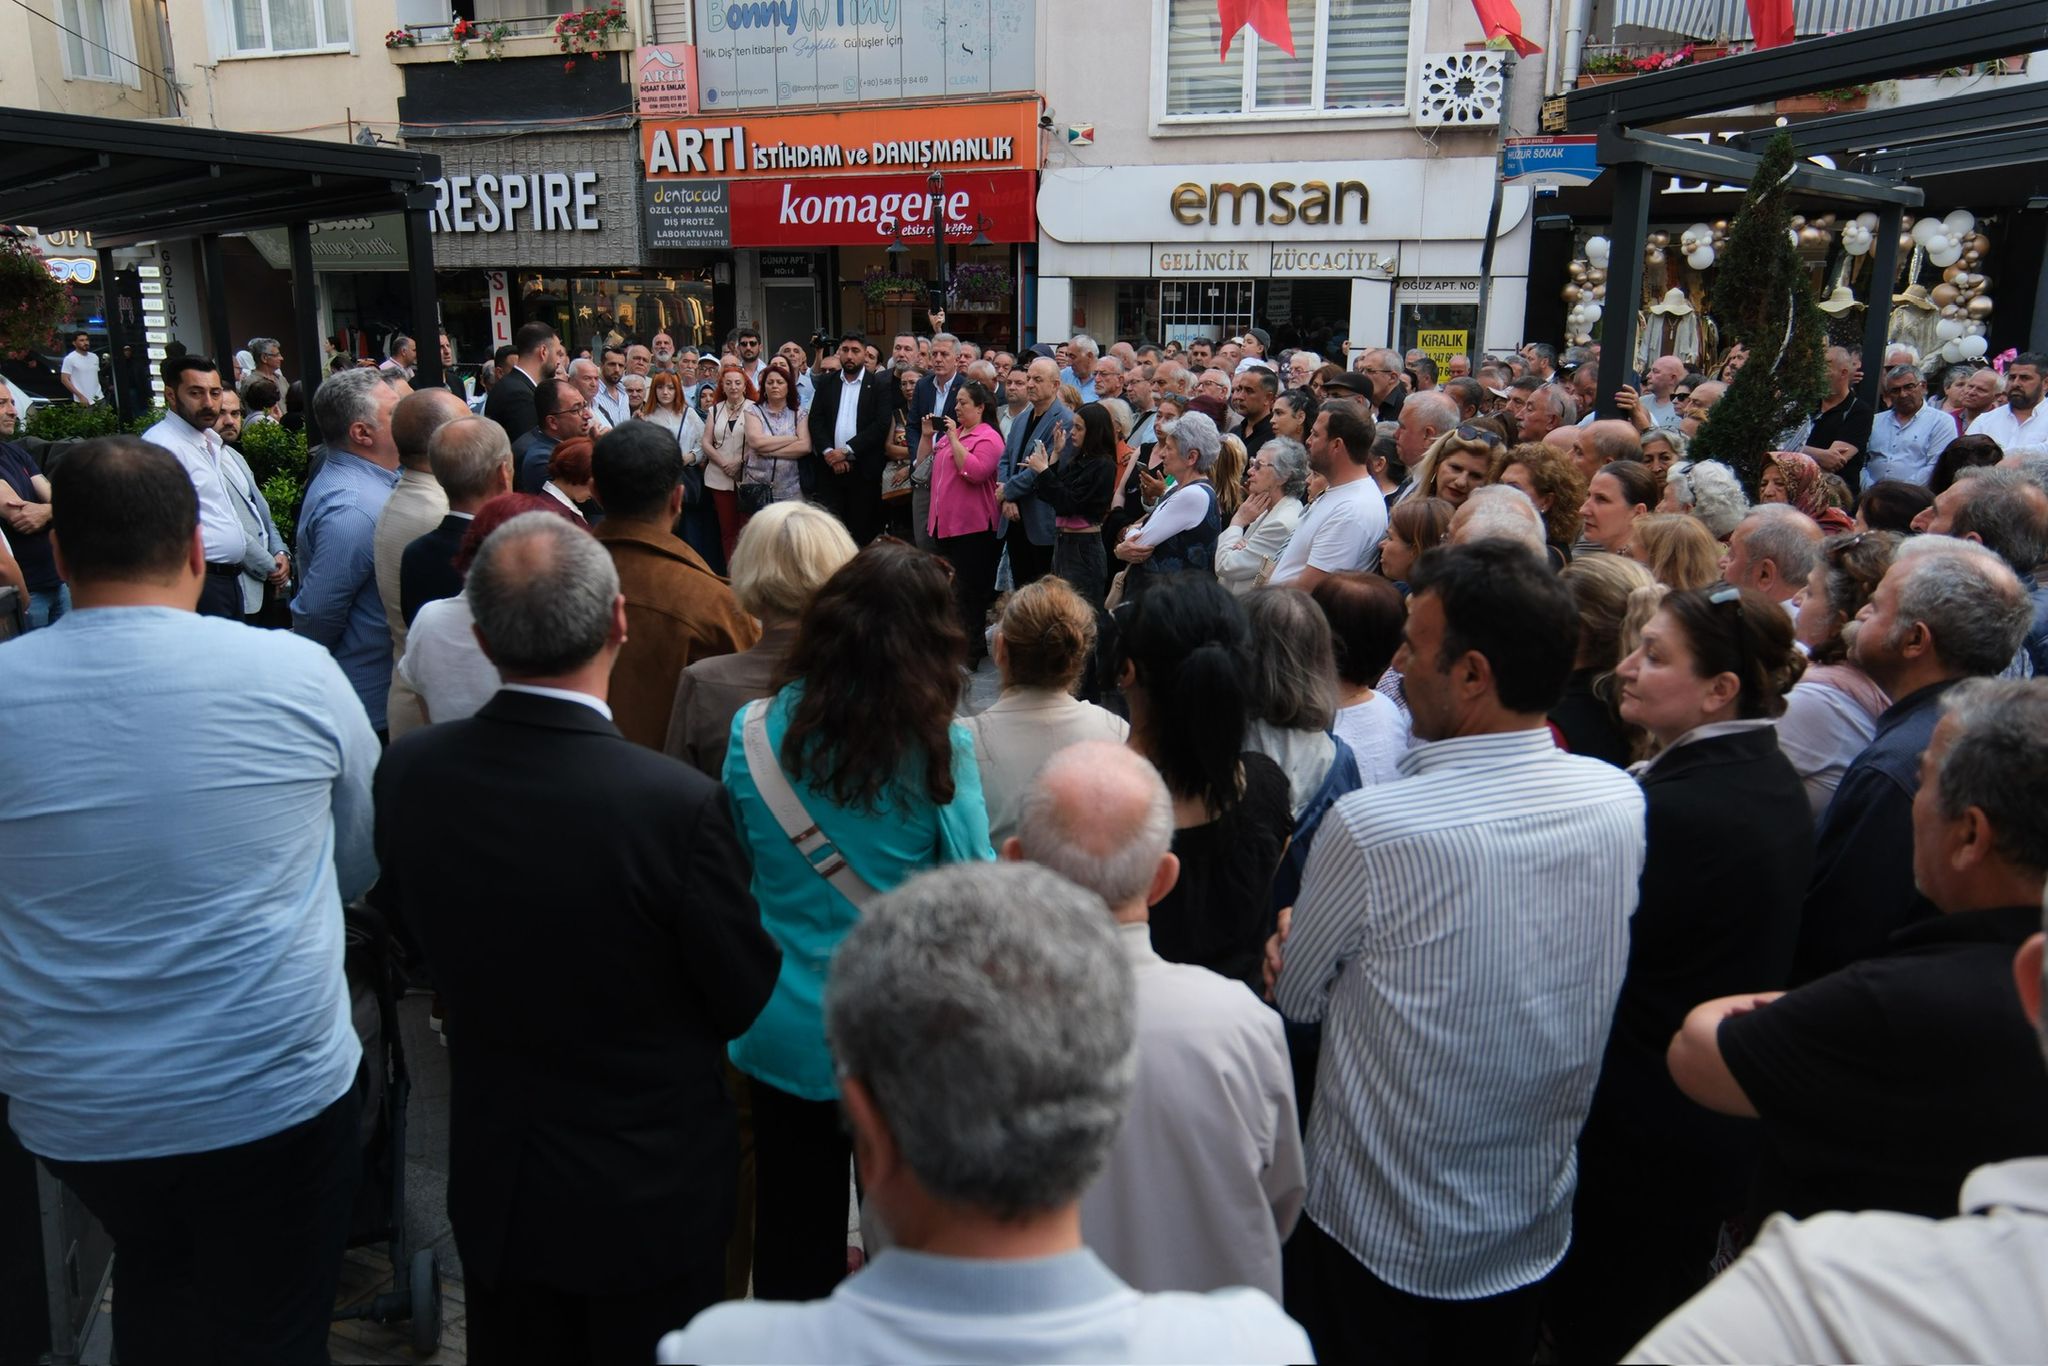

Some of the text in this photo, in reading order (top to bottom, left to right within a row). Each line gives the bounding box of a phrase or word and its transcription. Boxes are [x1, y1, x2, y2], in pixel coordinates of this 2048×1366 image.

[666, 83, 686, 91] EMLAK
[649, 126, 1013, 173] ARTI İSTİHDAM ve DANIŞMANLIK
[1507, 147, 1564, 159] HUZUR SOKAK
[654, 183, 721, 203] dentacad
[424, 172, 599, 232] RESPIRE
[1170, 180, 1370, 226] emsan
[673, 206, 693, 215] ÇOK
[694, 205, 728, 214] AMAÇLI
[779, 183, 969, 236] komagene
[664, 216, 715, 227] DİŞ PROTEZ
[656, 230, 723, 238] LABORATUVARI
[901, 224, 926, 236] etsiz
[1160, 247, 1378, 271] GELİNCİK ZÜCCACİYE
[1434, 281, 1457, 290] APT.
